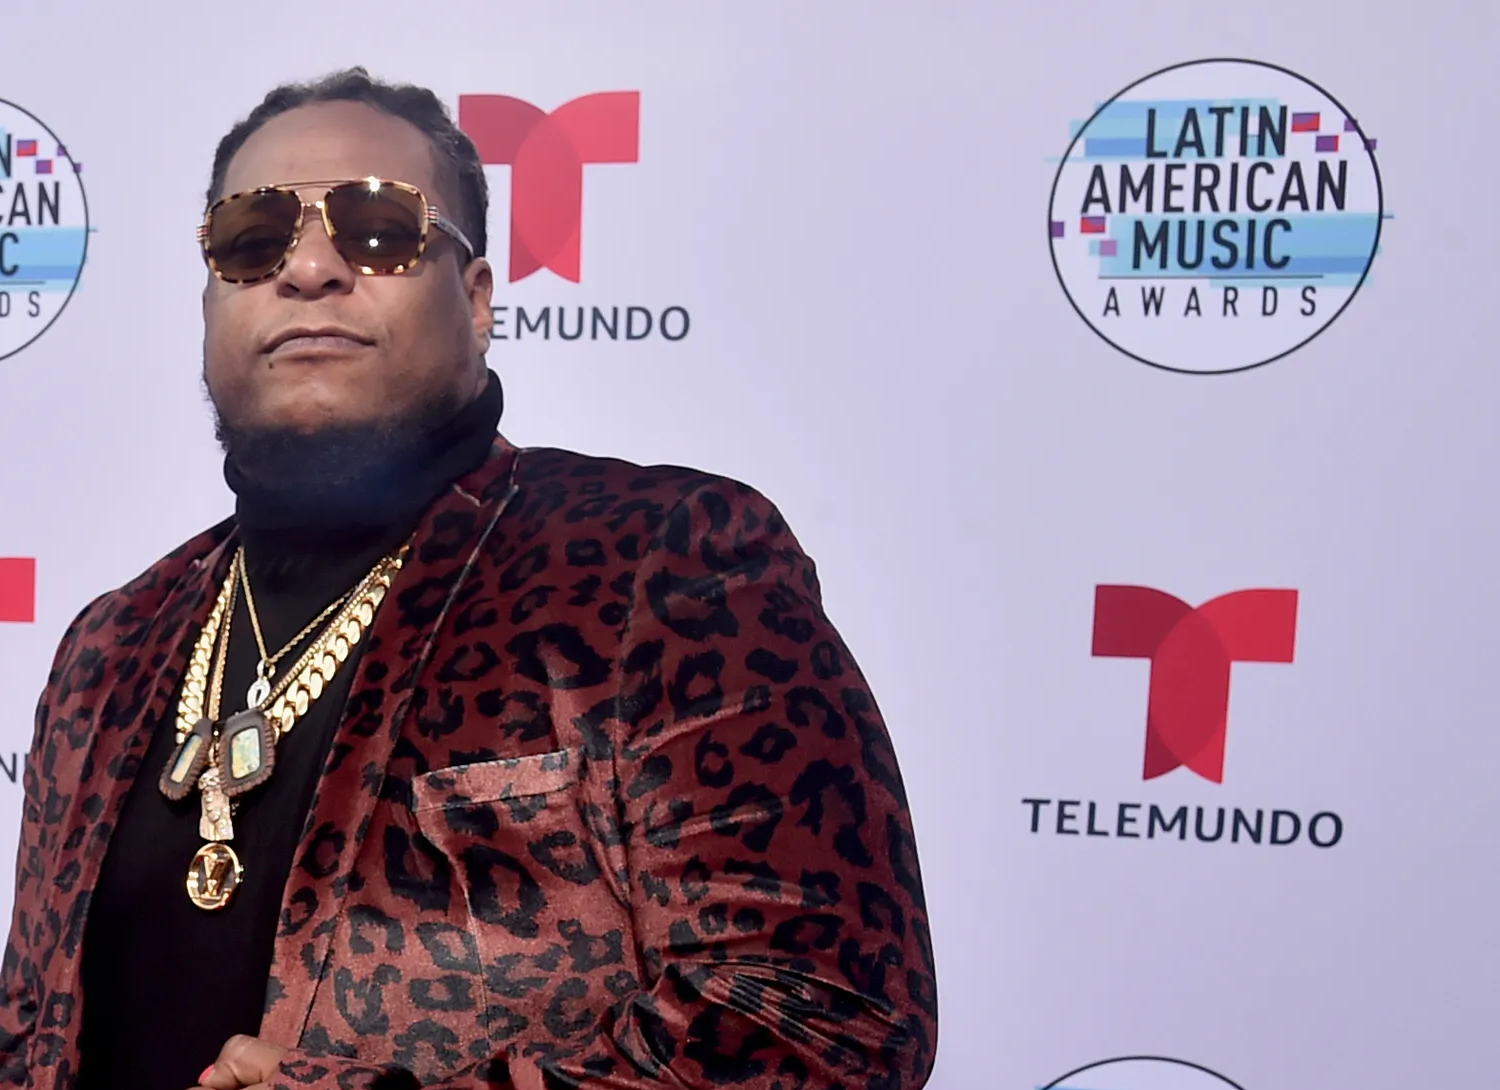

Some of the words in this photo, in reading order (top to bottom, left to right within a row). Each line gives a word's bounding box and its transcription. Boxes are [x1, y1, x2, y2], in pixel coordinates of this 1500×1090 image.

[1145, 105, 1288, 159] LATIN
[1080, 159, 1348, 214] AMERICAN
[1132, 218, 1292, 270] MUSIC
[488, 305, 690, 341] EMUNDO
[1103, 285, 1317, 317] AWARDS
[1021, 798, 1343, 848] TELEMUNDO
